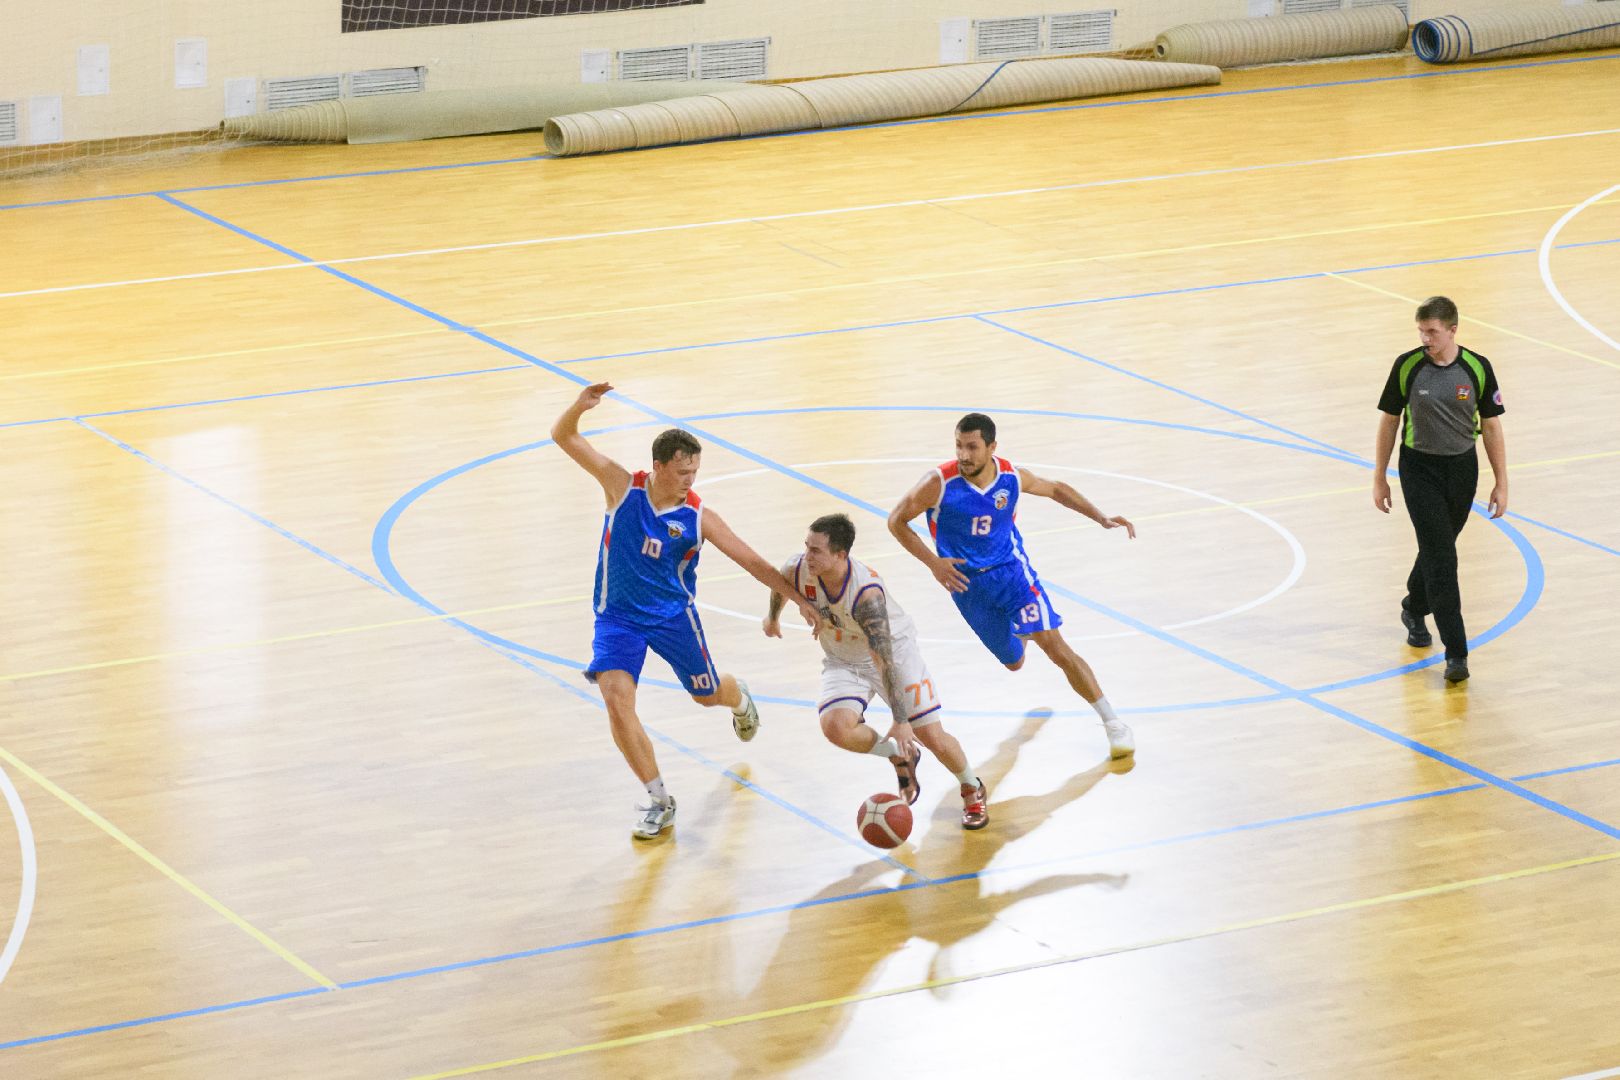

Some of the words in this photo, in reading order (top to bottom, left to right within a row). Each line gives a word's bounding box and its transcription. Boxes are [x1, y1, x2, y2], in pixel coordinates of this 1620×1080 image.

[971, 515, 993, 536] 13
[641, 535, 663, 560] 10
[1020, 603, 1040, 624] 13
[690, 673, 711, 690] 10
[904, 679, 934, 706] 77
